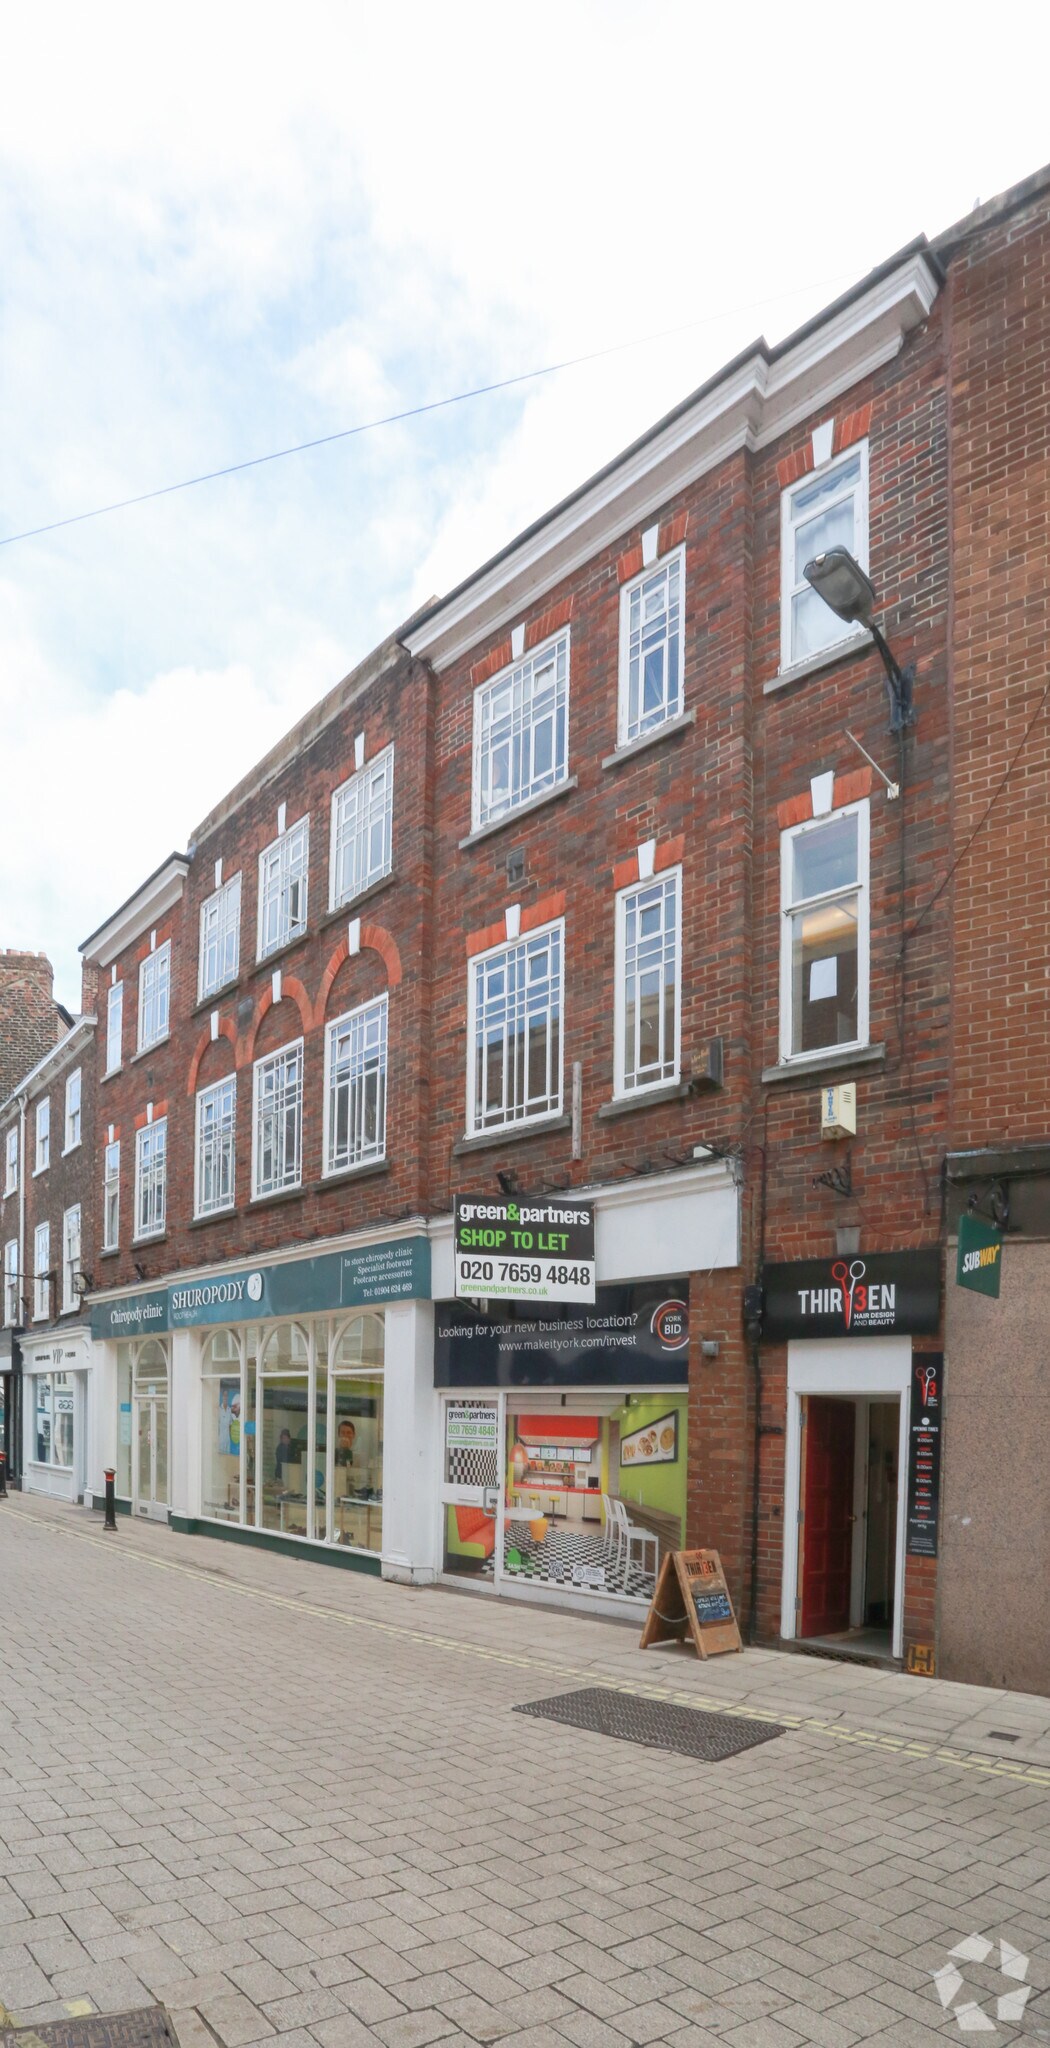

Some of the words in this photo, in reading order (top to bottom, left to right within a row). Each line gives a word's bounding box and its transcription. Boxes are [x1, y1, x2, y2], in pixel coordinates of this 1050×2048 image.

[459, 1203, 591, 1225] green&partners
[460, 1228, 507, 1247] SHOP
[511, 1231, 533, 1249] TO
[538, 1233, 570, 1251] LET
[344, 1259, 351, 1267] In
[351, 1257, 365, 1266] store
[365, 1250, 395, 1263] chiropody
[395, 1247, 413, 1257] clinic
[962, 1244, 1000, 1273] SUBWAY
[357, 1262, 386, 1275] Specialist
[386, 1259, 413, 1269] footwear
[460, 1261, 493, 1280] 020
[498, 1263, 542, 1283] 7659
[546, 1265, 591, 1286] 4848
[353, 1275, 378, 1285] Footcare
[378, 1269, 413, 1281] accessories
[172, 1280, 246, 1310] SHUROPODY
[374, 1286, 390, 1296] 01904
[390, 1284, 401, 1293] 624
[460, 1283, 548, 1296] greenandpartners.co.uk
[110, 1306, 142, 1325] Chiropody
[143, 1304, 163, 1320] clinic
[870, 1311, 895, 1319] DESIGN
[438, 1326, 473, 1339] Looking
[475, 1324, 488, 1336] for
[490, 1324, 512, 1338] your
[514, 1323, 536, 1333] new
[538, 1318, 584, 1332] business
[586, 1313, 639, 1329] location?
[664, 1324, 682, 1335] BID
[498, 1334, 637, 1351] www.makeityork.com/invest
[448, 1410, 496, 1421] green&partners
[448, 1424, 460, 1434] 020
[461, 1425, 477, 1435] 7659
[478, 1426, 496, 1436] 4848
